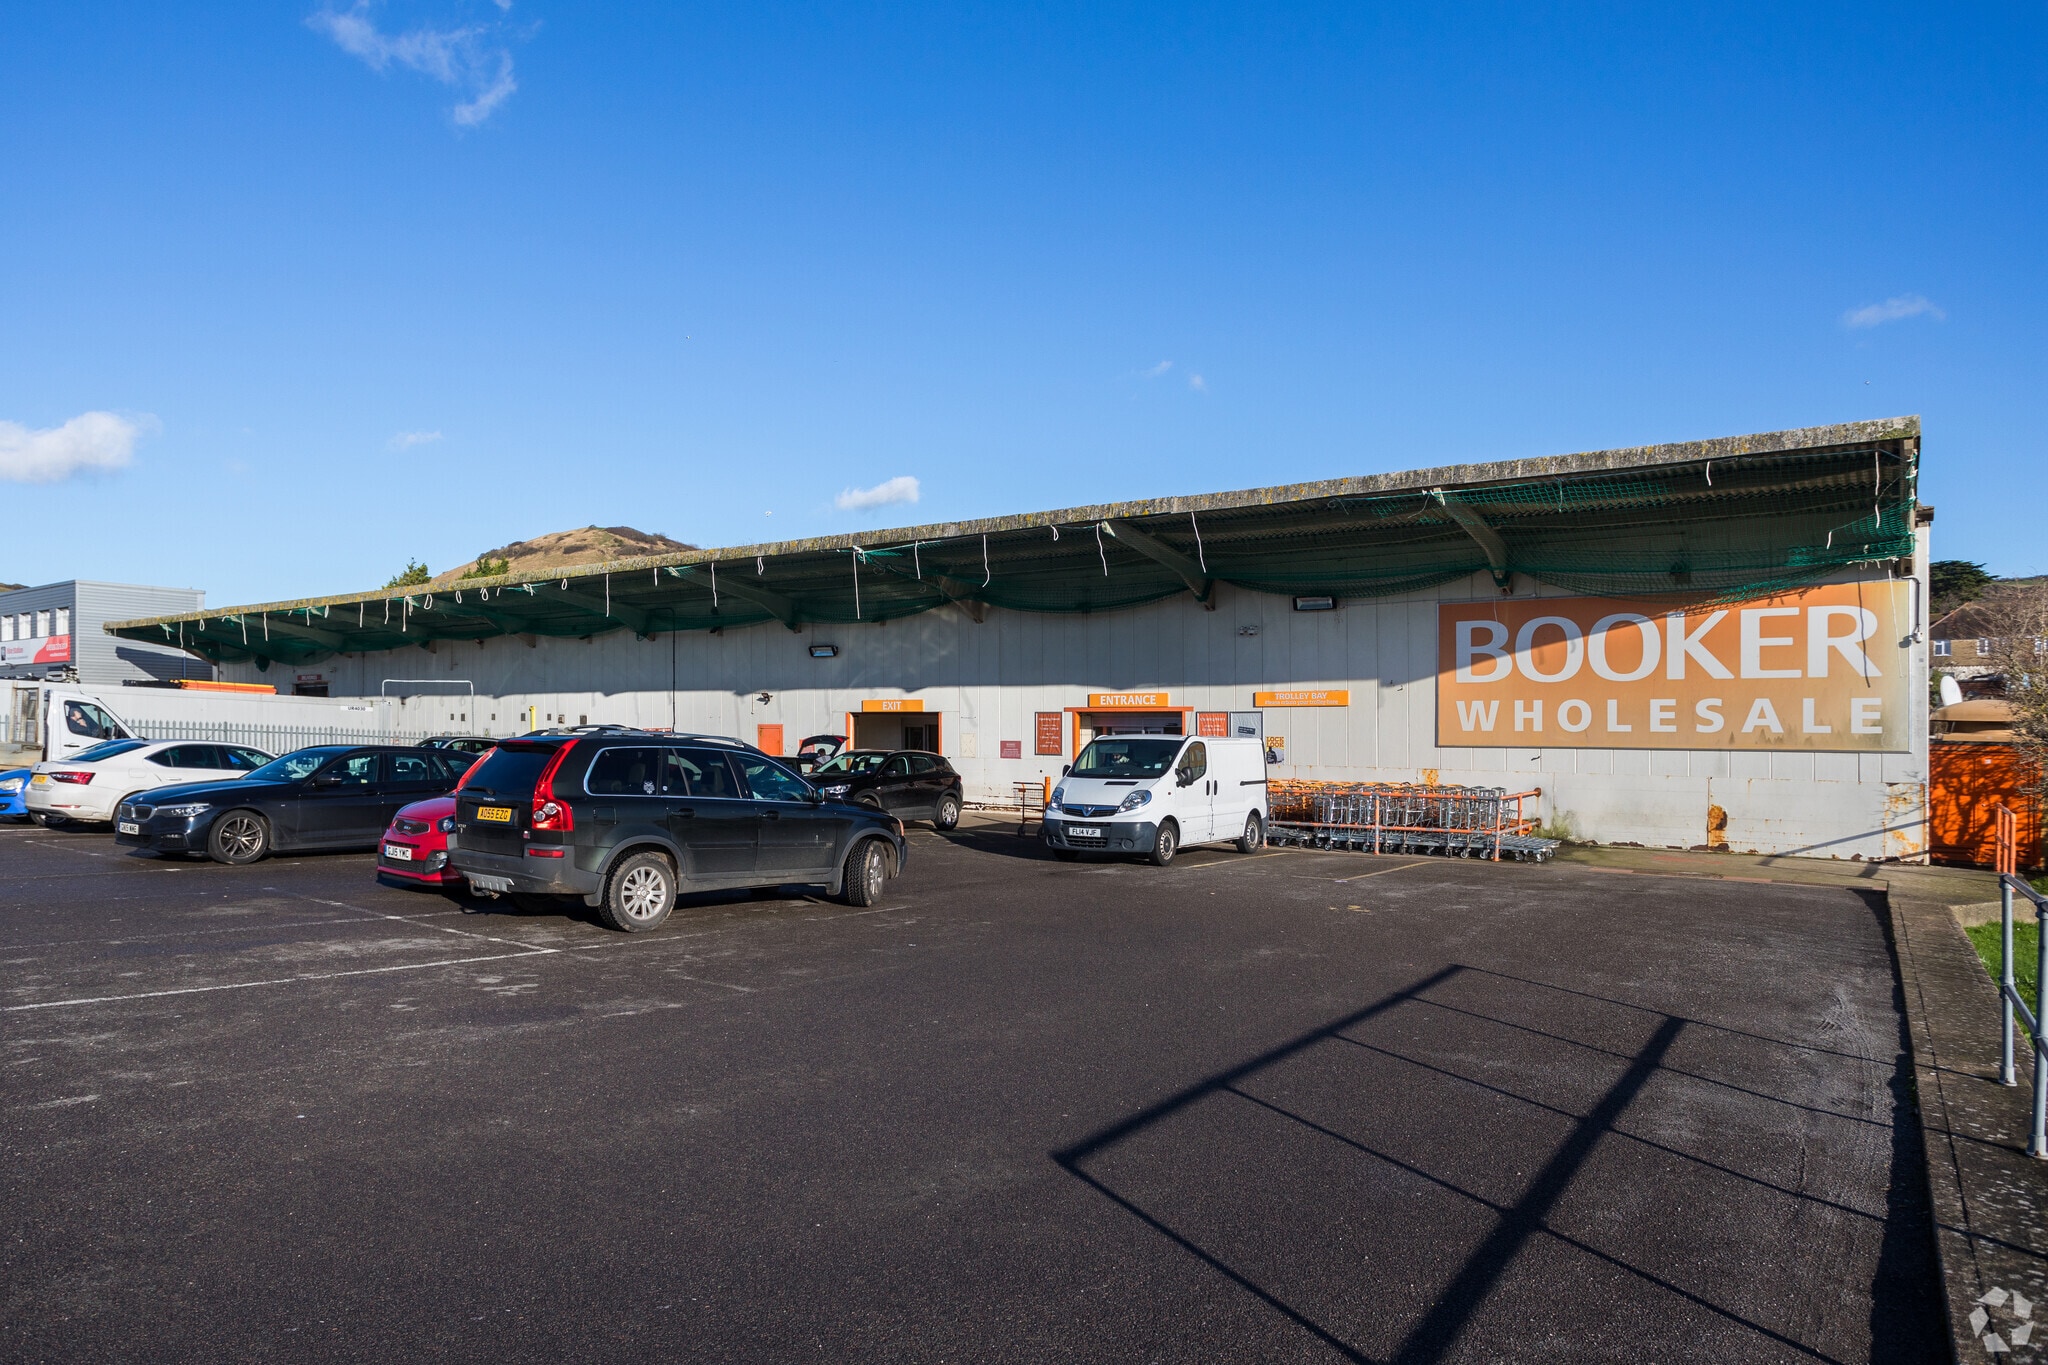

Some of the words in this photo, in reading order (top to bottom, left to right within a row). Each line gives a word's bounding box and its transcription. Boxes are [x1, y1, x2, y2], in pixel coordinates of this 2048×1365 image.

[1455, 605, 1882, 684] BOOKER
[1100, 695, 1157, 705] ENTRANCE
[1275, 692, 1309, 700] TROLLEY
[1311, 692, 1328, 700] BAY
[882, 701, 902, 711] EXIT
[1456, 697, 1883, 735] WHOLESALE
[495, 809, 509, 820] EZG
